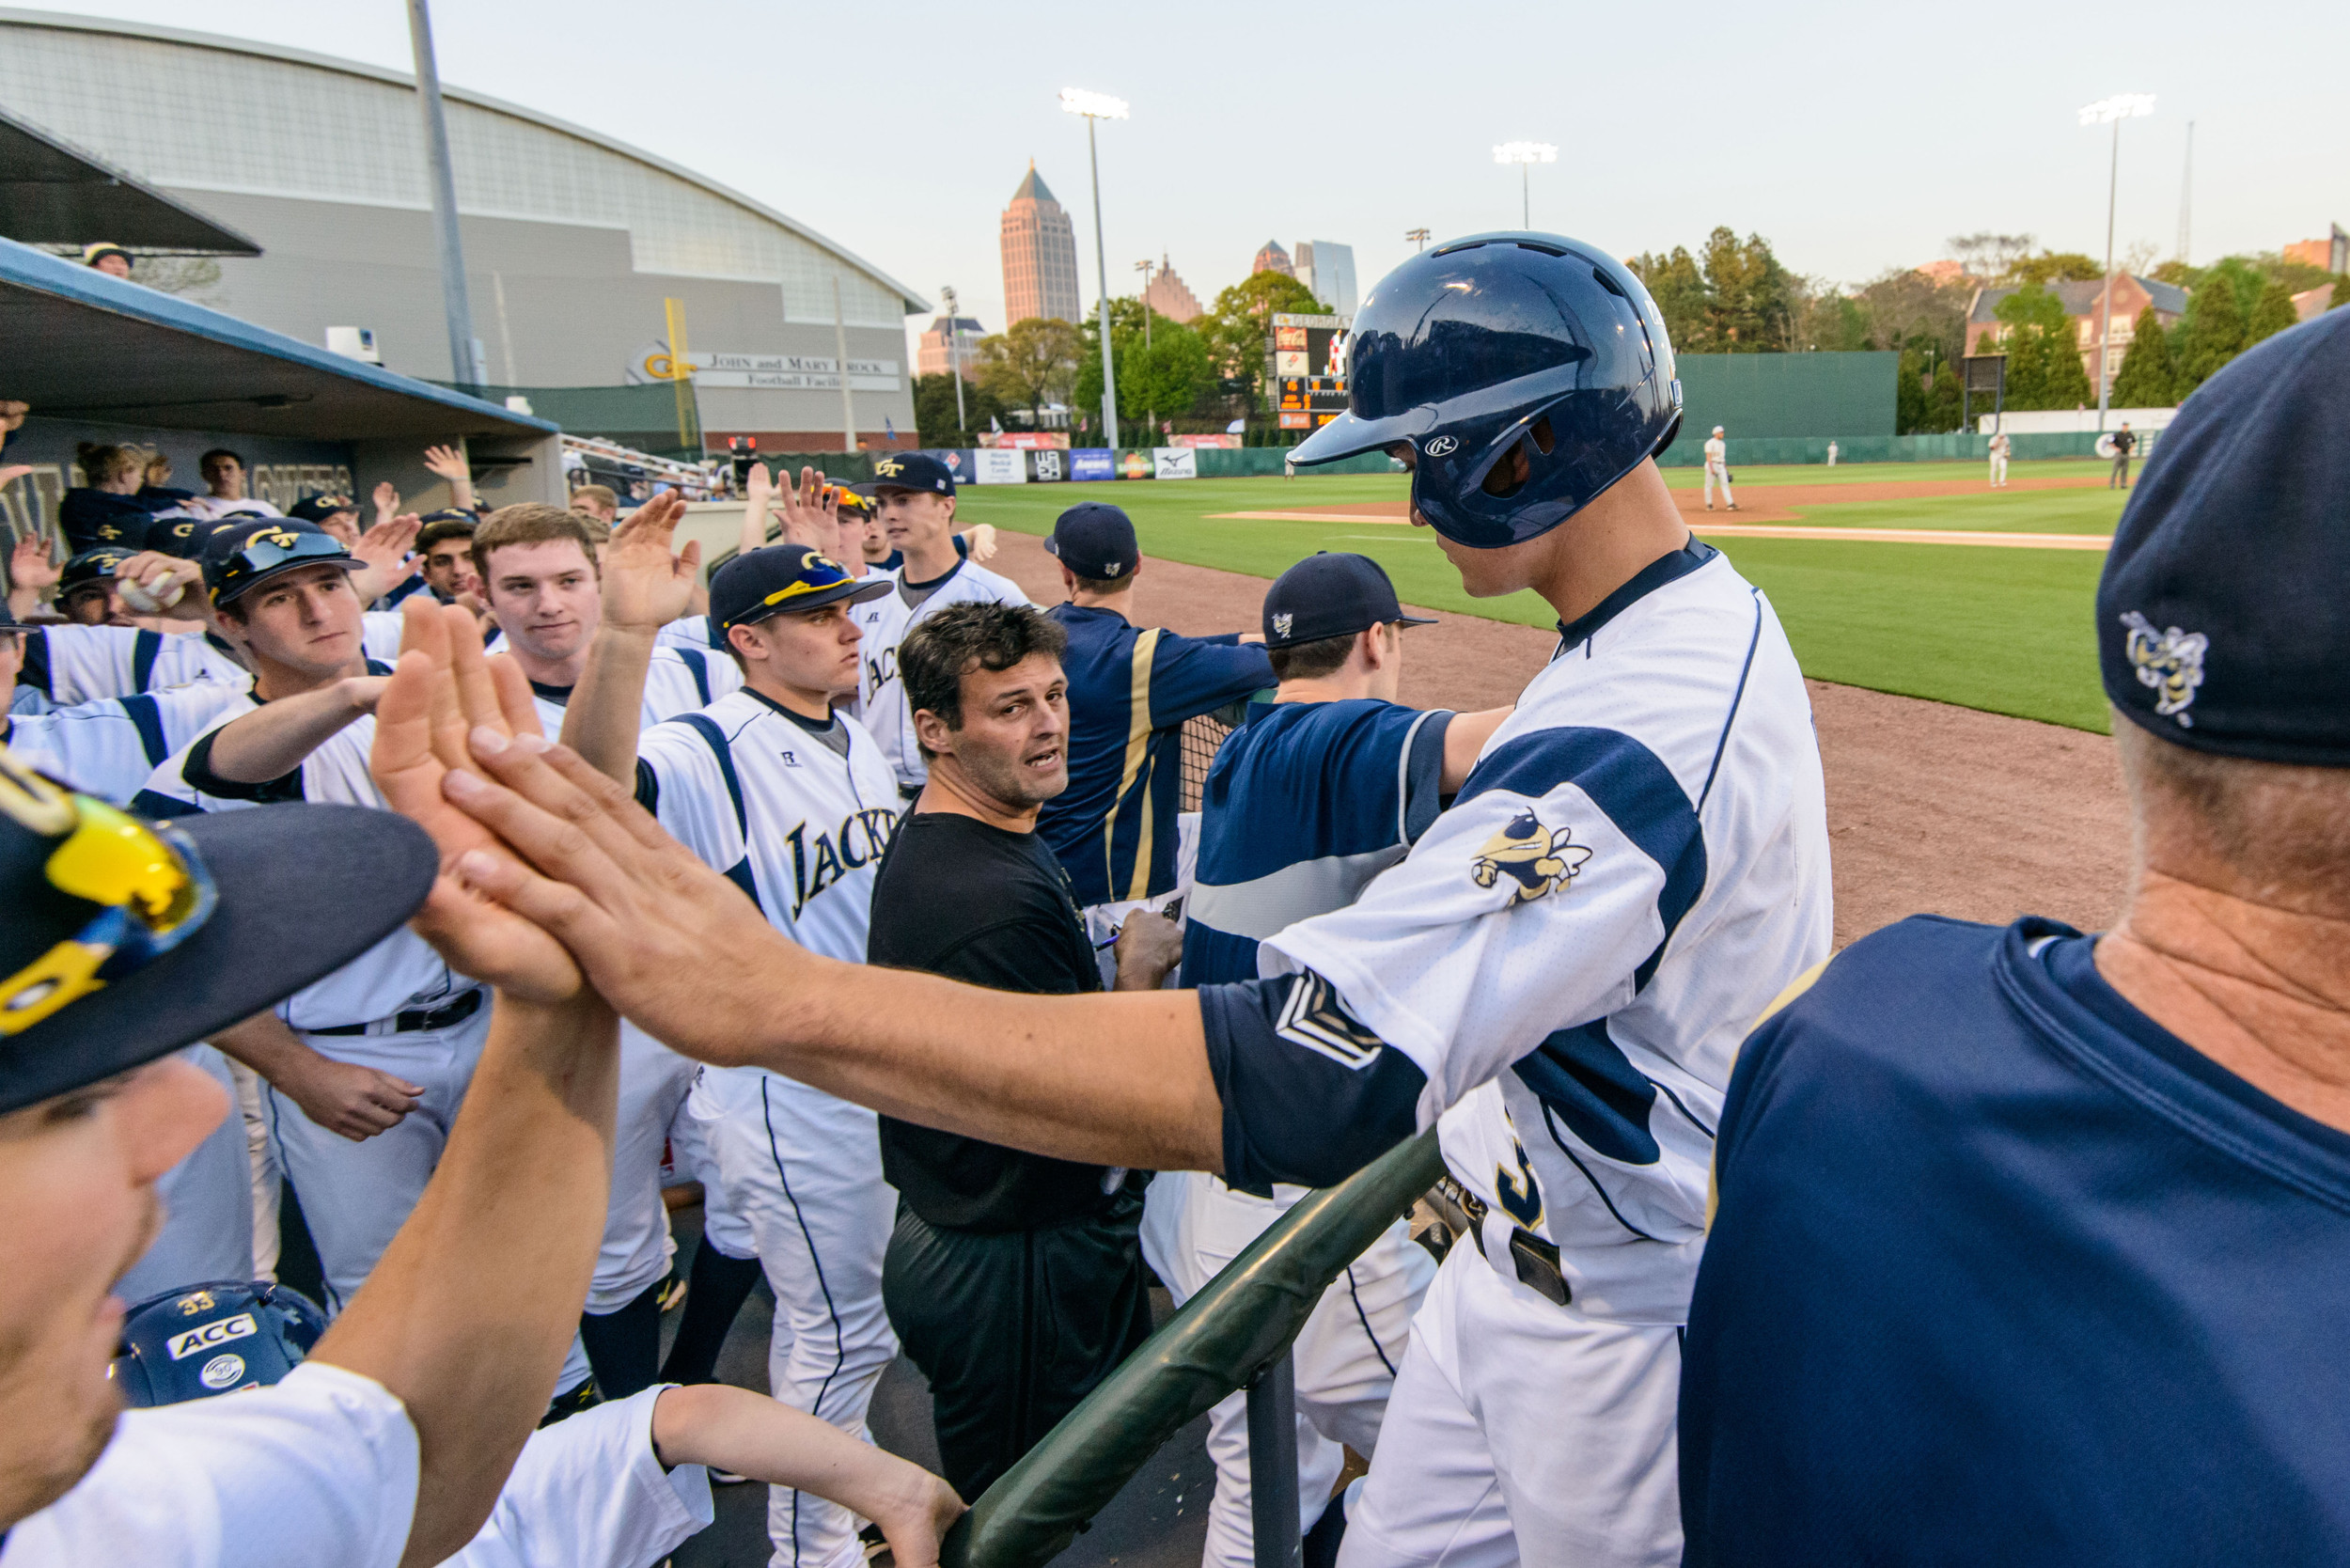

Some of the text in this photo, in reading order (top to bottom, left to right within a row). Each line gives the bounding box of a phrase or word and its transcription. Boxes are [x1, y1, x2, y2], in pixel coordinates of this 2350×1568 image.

[711, 353, 751, 367] JOHN
[757, 358, 781, 369] and
[789, 357, 830, 371] MARY
[748, 374, 801, 385] Football
[875, 458, 904, 478] GT
[178, 1291, 215, 1316] 33
[176, 1318, 247, 1357] ACC
